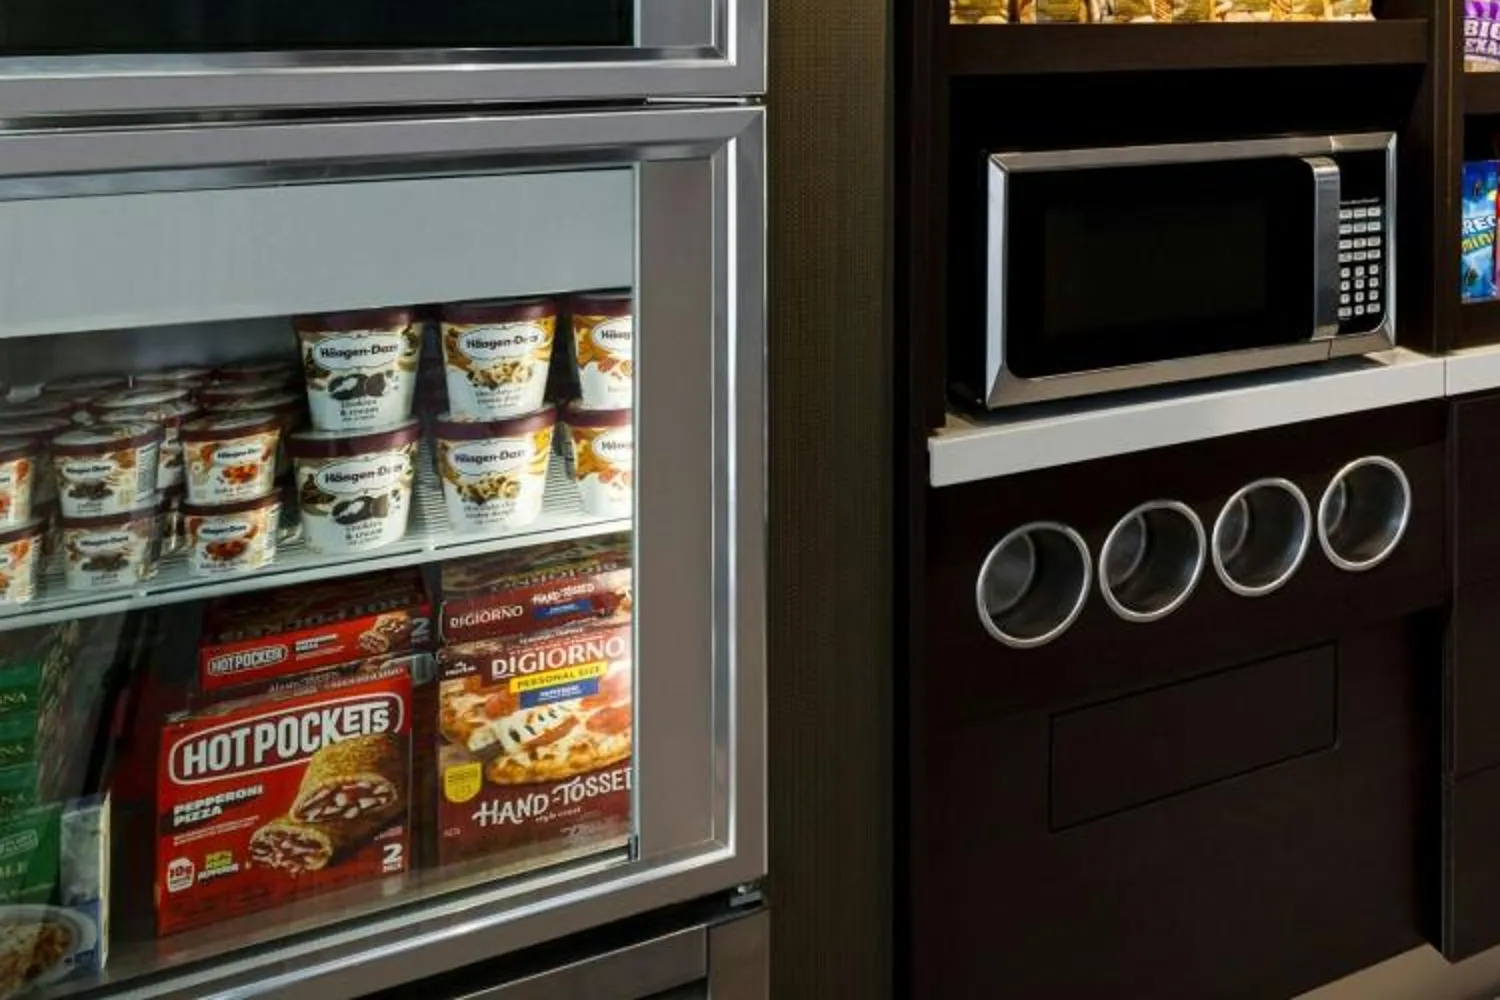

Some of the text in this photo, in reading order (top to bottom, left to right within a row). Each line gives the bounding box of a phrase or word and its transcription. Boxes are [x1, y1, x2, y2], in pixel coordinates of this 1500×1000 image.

[1463, 215, 1496, 234] REO
[412, 618, 429, 636] 2
[517, 671, 576, 690] PERSONAL
[183, 701, 391, 777] HOT POCKETS
[173, 784, 263, 814] PEPPERONI
[173, 805, 223, 828] PIZZA
[382, 843, 404, 865] 2
